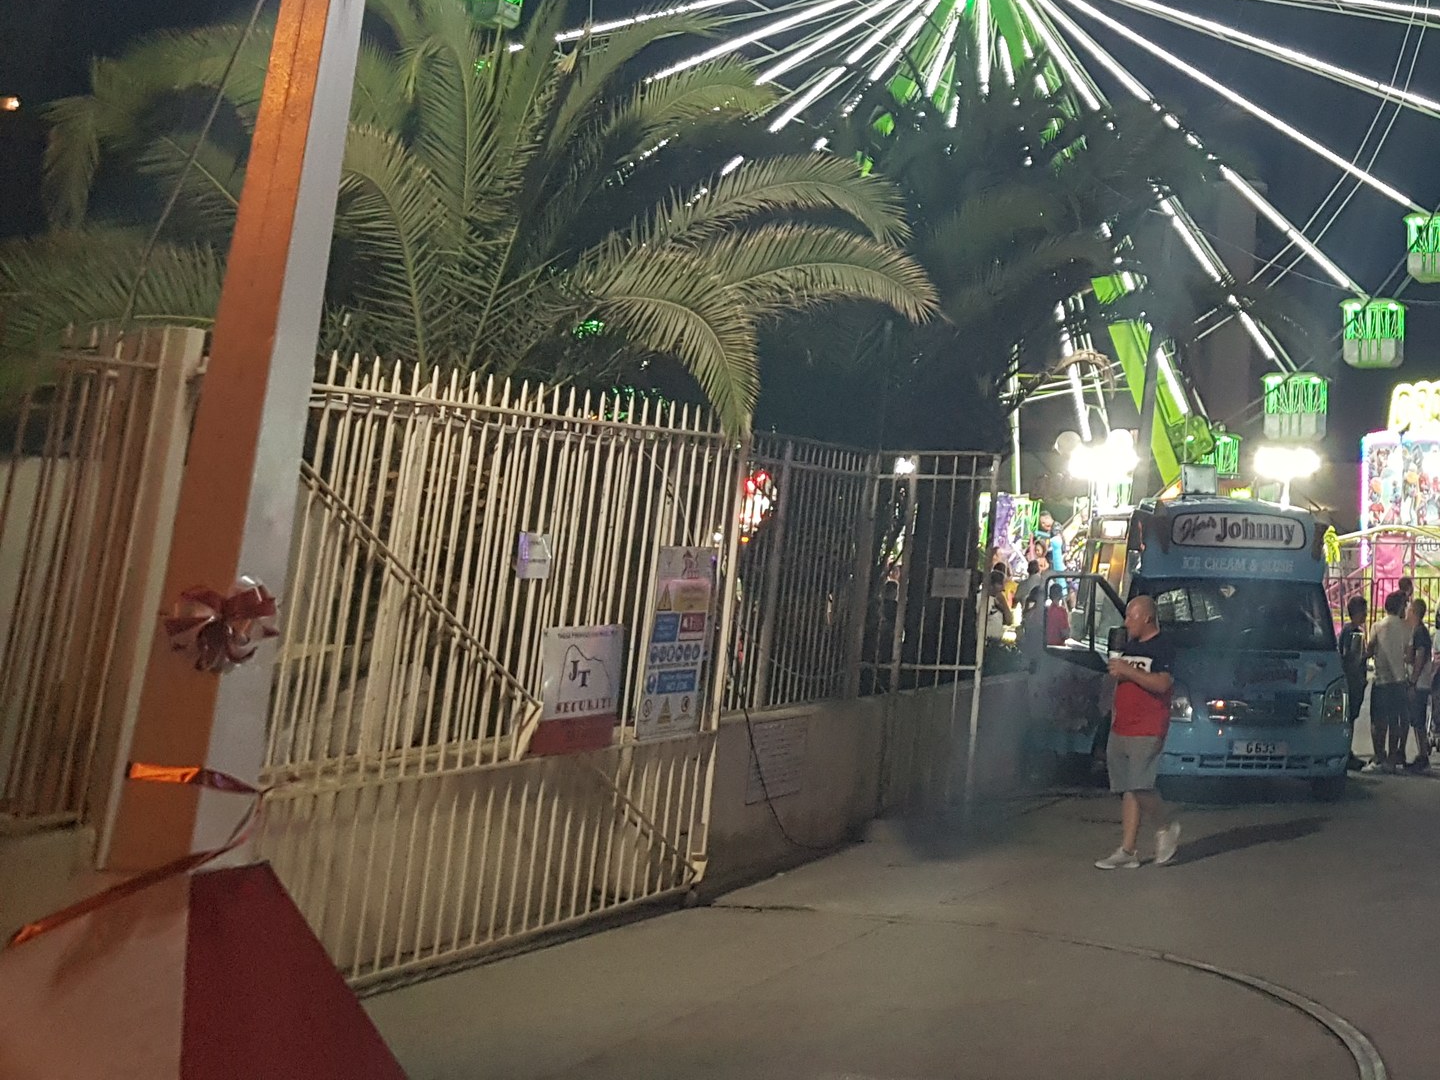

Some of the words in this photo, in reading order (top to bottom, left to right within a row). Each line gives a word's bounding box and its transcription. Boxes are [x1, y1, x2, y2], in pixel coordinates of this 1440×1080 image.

[1216, 517, 1294, 545] Johnny
[1205, 557, 1247, 571] CREAM
[556, 698, 611, 713] SECURITY
